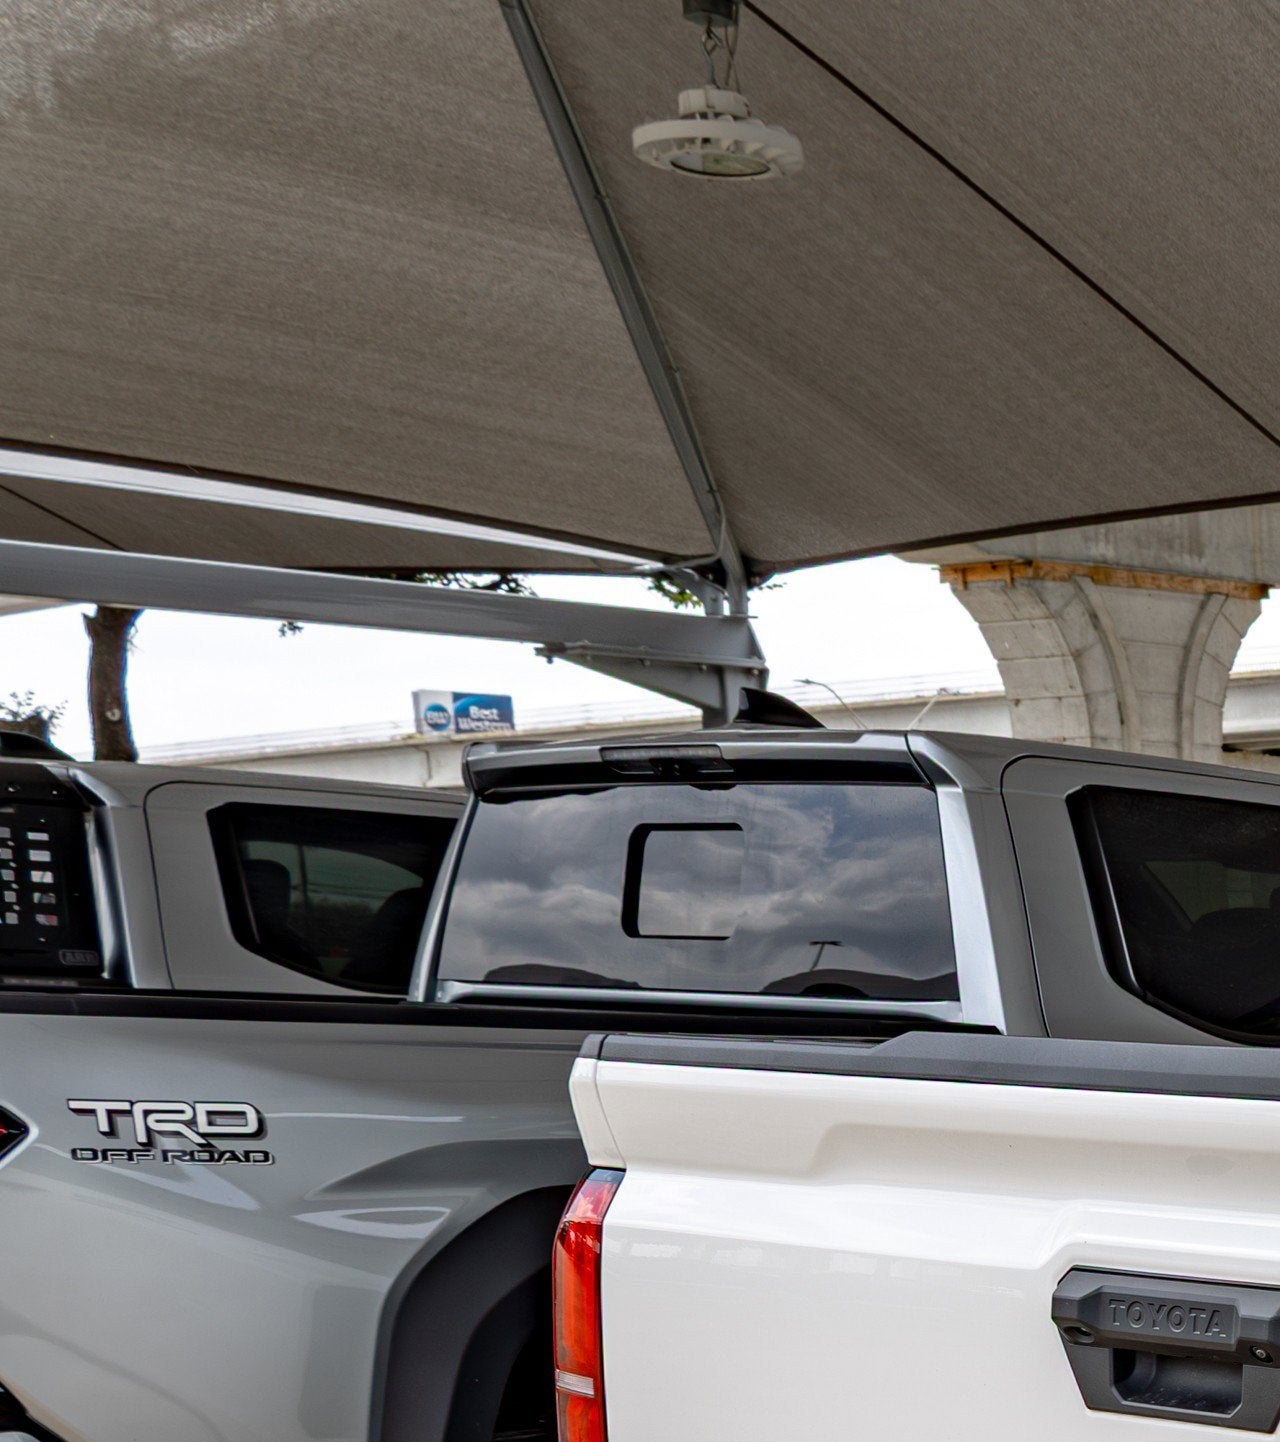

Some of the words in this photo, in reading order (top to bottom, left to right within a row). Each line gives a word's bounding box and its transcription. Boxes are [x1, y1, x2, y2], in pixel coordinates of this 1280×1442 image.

[469, 706, 499, 720] Best
[67, 1099, 267, 1148] TRD
[71, 1148, 155, 1164] OFF
[161, 1149, 274, 1165] ROAD
[1108, 1299, 1227, 1338] TOYOTA
